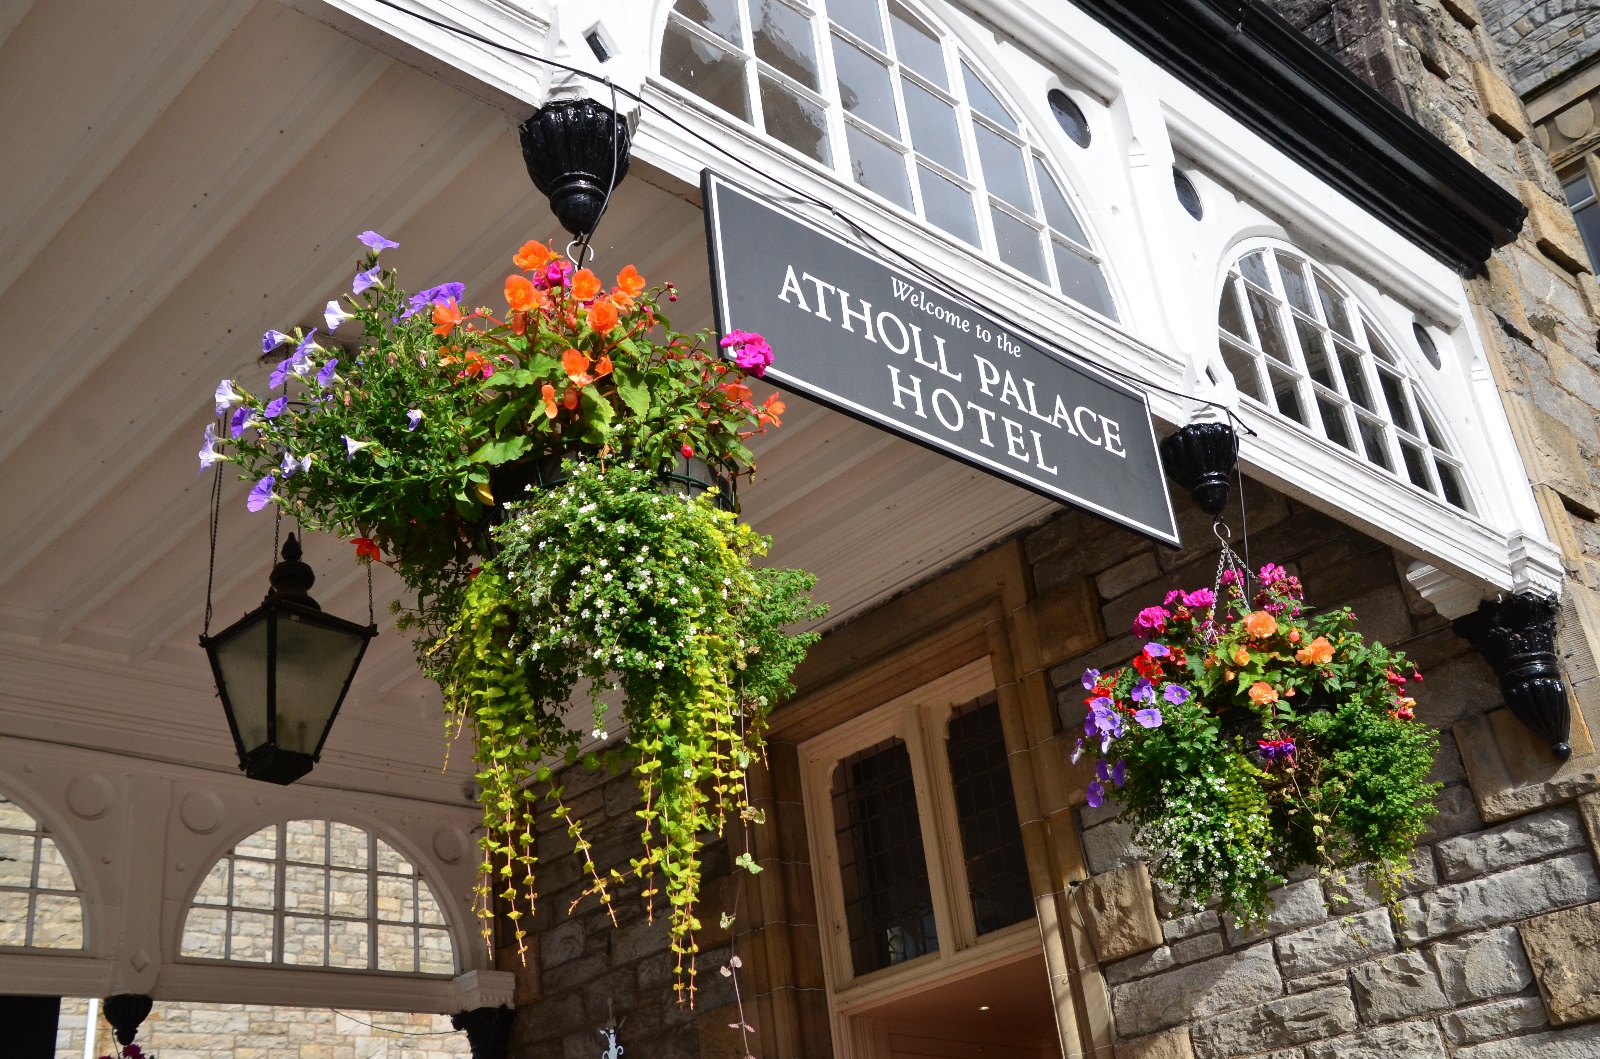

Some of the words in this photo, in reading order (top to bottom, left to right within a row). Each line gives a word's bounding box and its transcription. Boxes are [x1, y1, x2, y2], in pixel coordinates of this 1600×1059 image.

[778, 265, 962, 382] ATHOLL
[973, 354, 1127, 459] PALACE
[890, 276, 970, 333] Welcome
[975, 324, 992, 343] to
[996, 332, 1022, 358] the
[887, 365, 1058, 475] HOTEL
